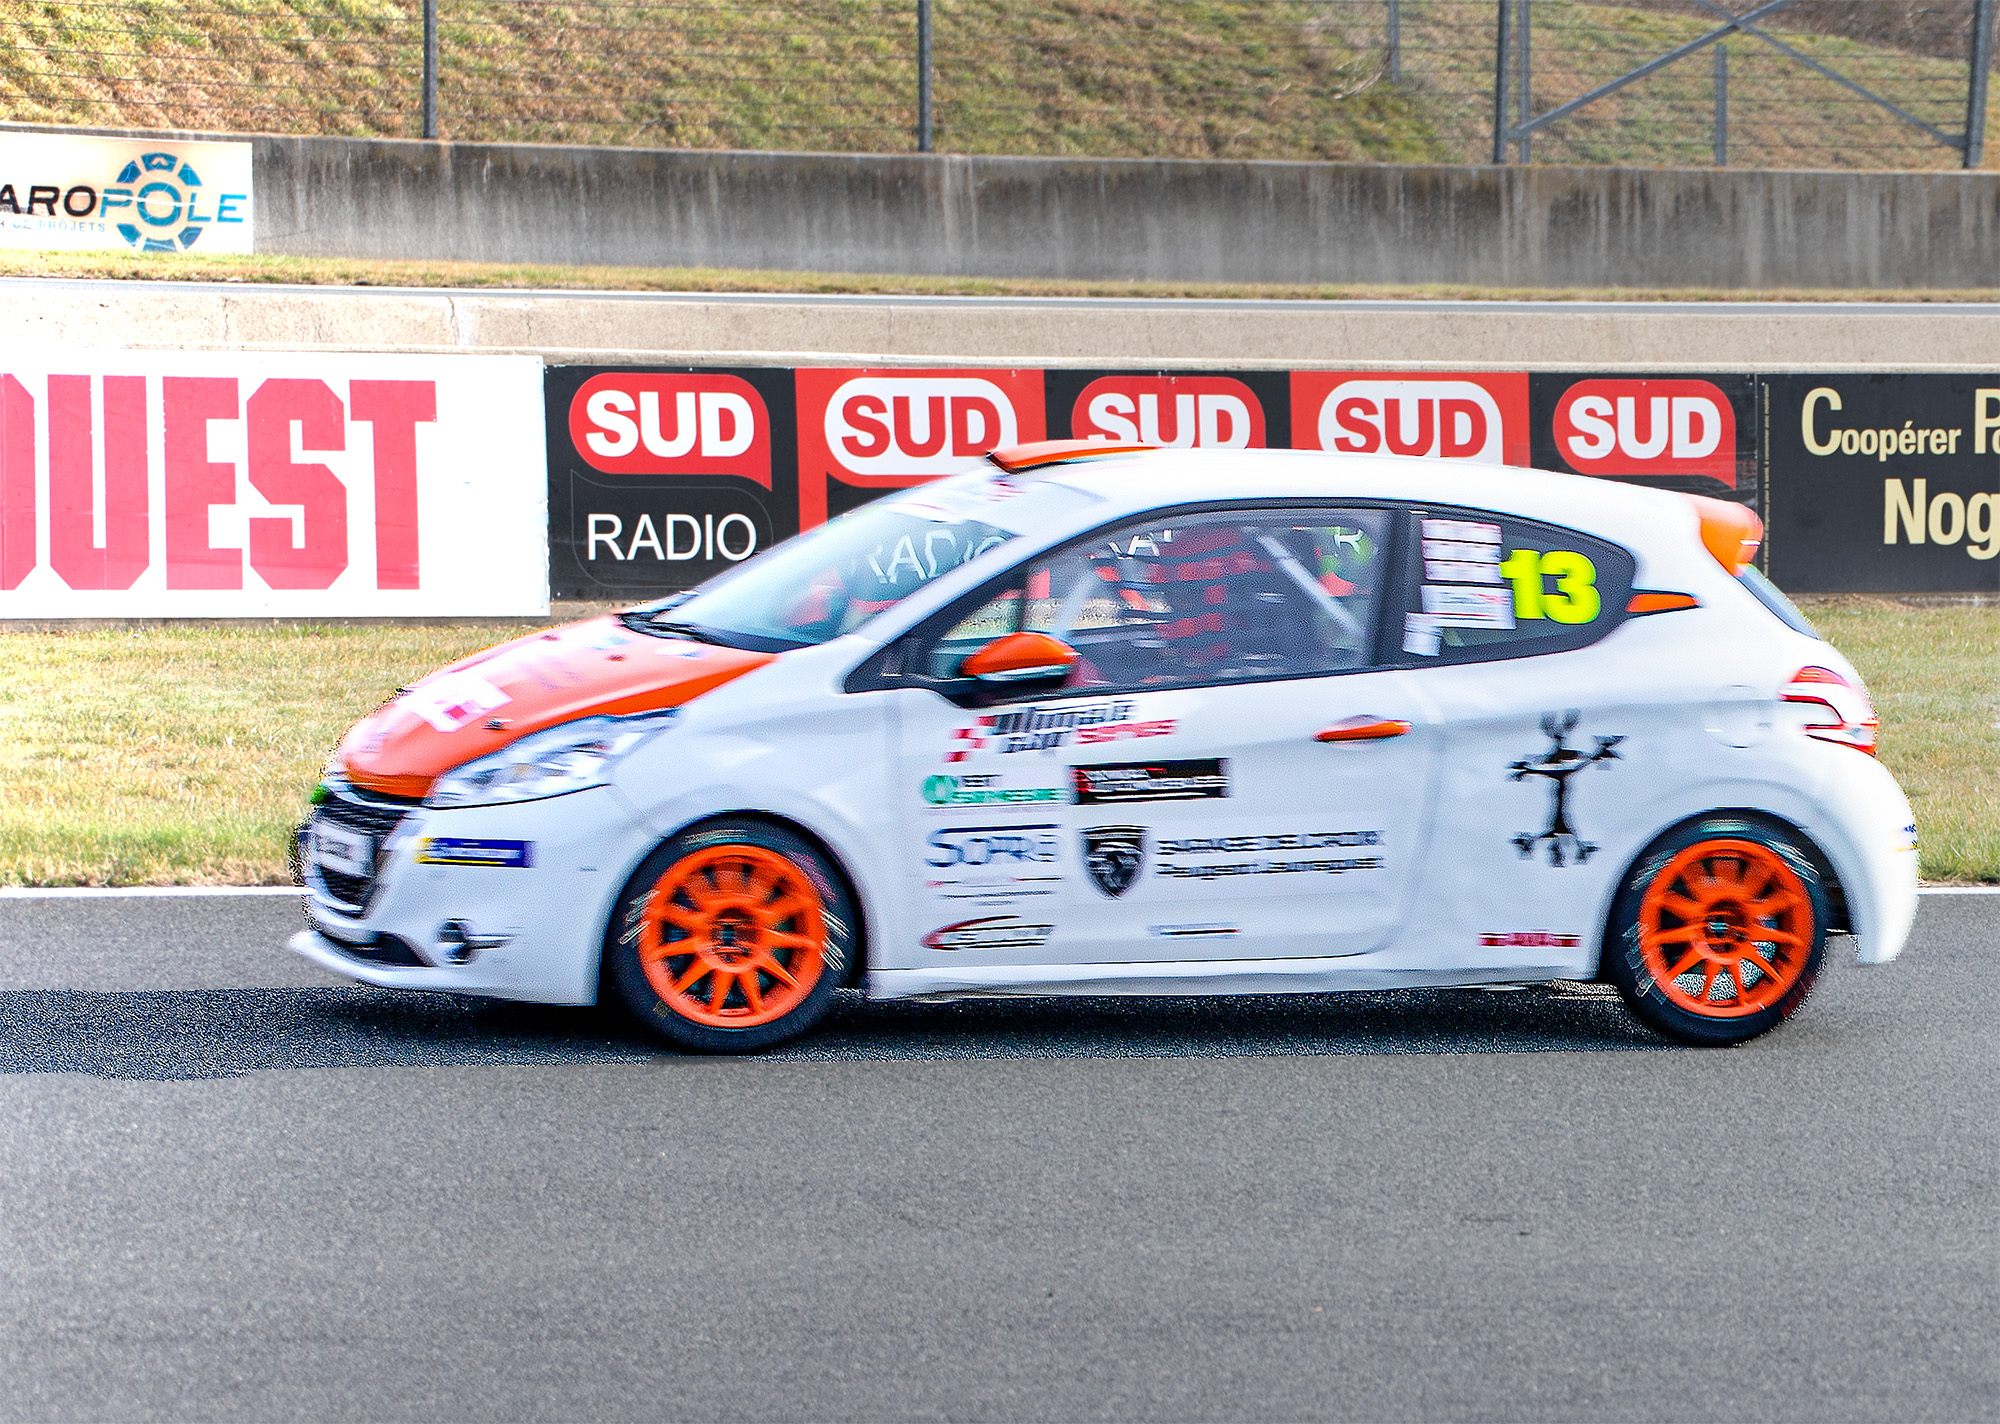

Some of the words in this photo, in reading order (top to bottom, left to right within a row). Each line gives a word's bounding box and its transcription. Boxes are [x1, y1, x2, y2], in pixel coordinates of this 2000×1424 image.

[586, 390, 755, 458] SUD
[841, 395, 1002, 458] SUD
[1087, 393, 1251, 449] SUD
[1334, 397, 1488, 458] SUD
[1568, 395, 1722, 459] SUD
[1801, 387, 1962, 462] Coopérer
[587, 513, 757, 562] RADIO
[1884, 478, 2000, 560] Nog
[1499, 550, 1601, 624] 13
